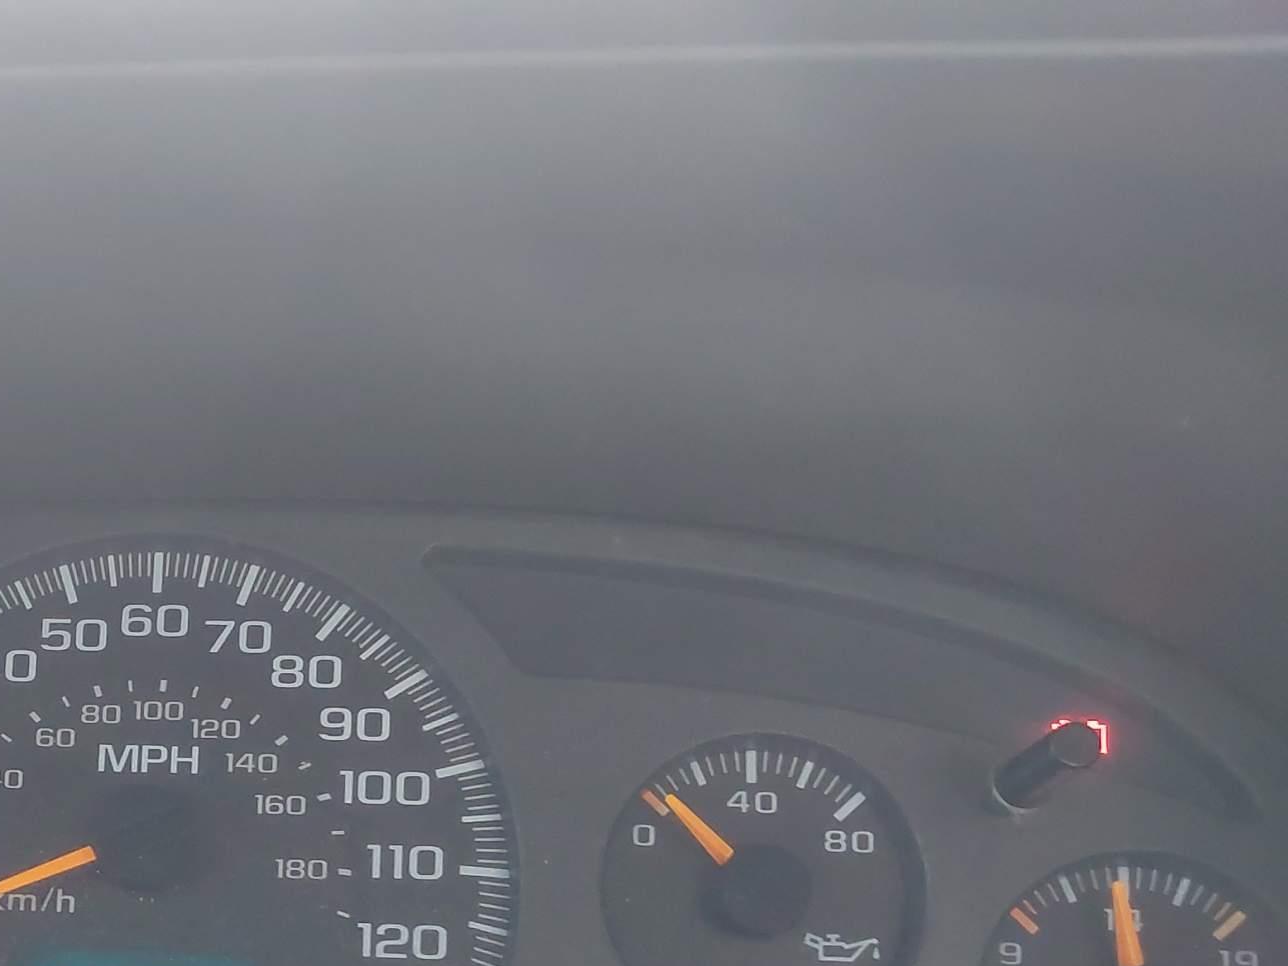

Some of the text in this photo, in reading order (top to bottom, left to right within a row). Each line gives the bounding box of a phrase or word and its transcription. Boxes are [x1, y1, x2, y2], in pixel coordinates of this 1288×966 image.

[119, 604, 189, 639] 60
[40, 618, 108, 652] 50
[205, 619, 272, 654] 70
[271, 655, 342, 689] 80
[81, 703, 121, 725] 80
[133, 700, 184, 722] 100
[191, 718, 241, 740] 120
[318, 707, 391, 742] 90
[35, 727, 75, 748] 60
[97, 745, 200, 774] MPH
[225, 753, 278, 774] 140
[339, 770, 431, 806] 100
[255, 794, 306, 816] 160
[726, 790, 778, 814] 40
[633, 825, 656, 847] 0
[824, 831, 874, 853] 80
[275, 858, 327, 879] 180
[367, 845, 444, 880] 110
[357, 923, 449, 960] 120
[999, 942, 1022, 965] 9
